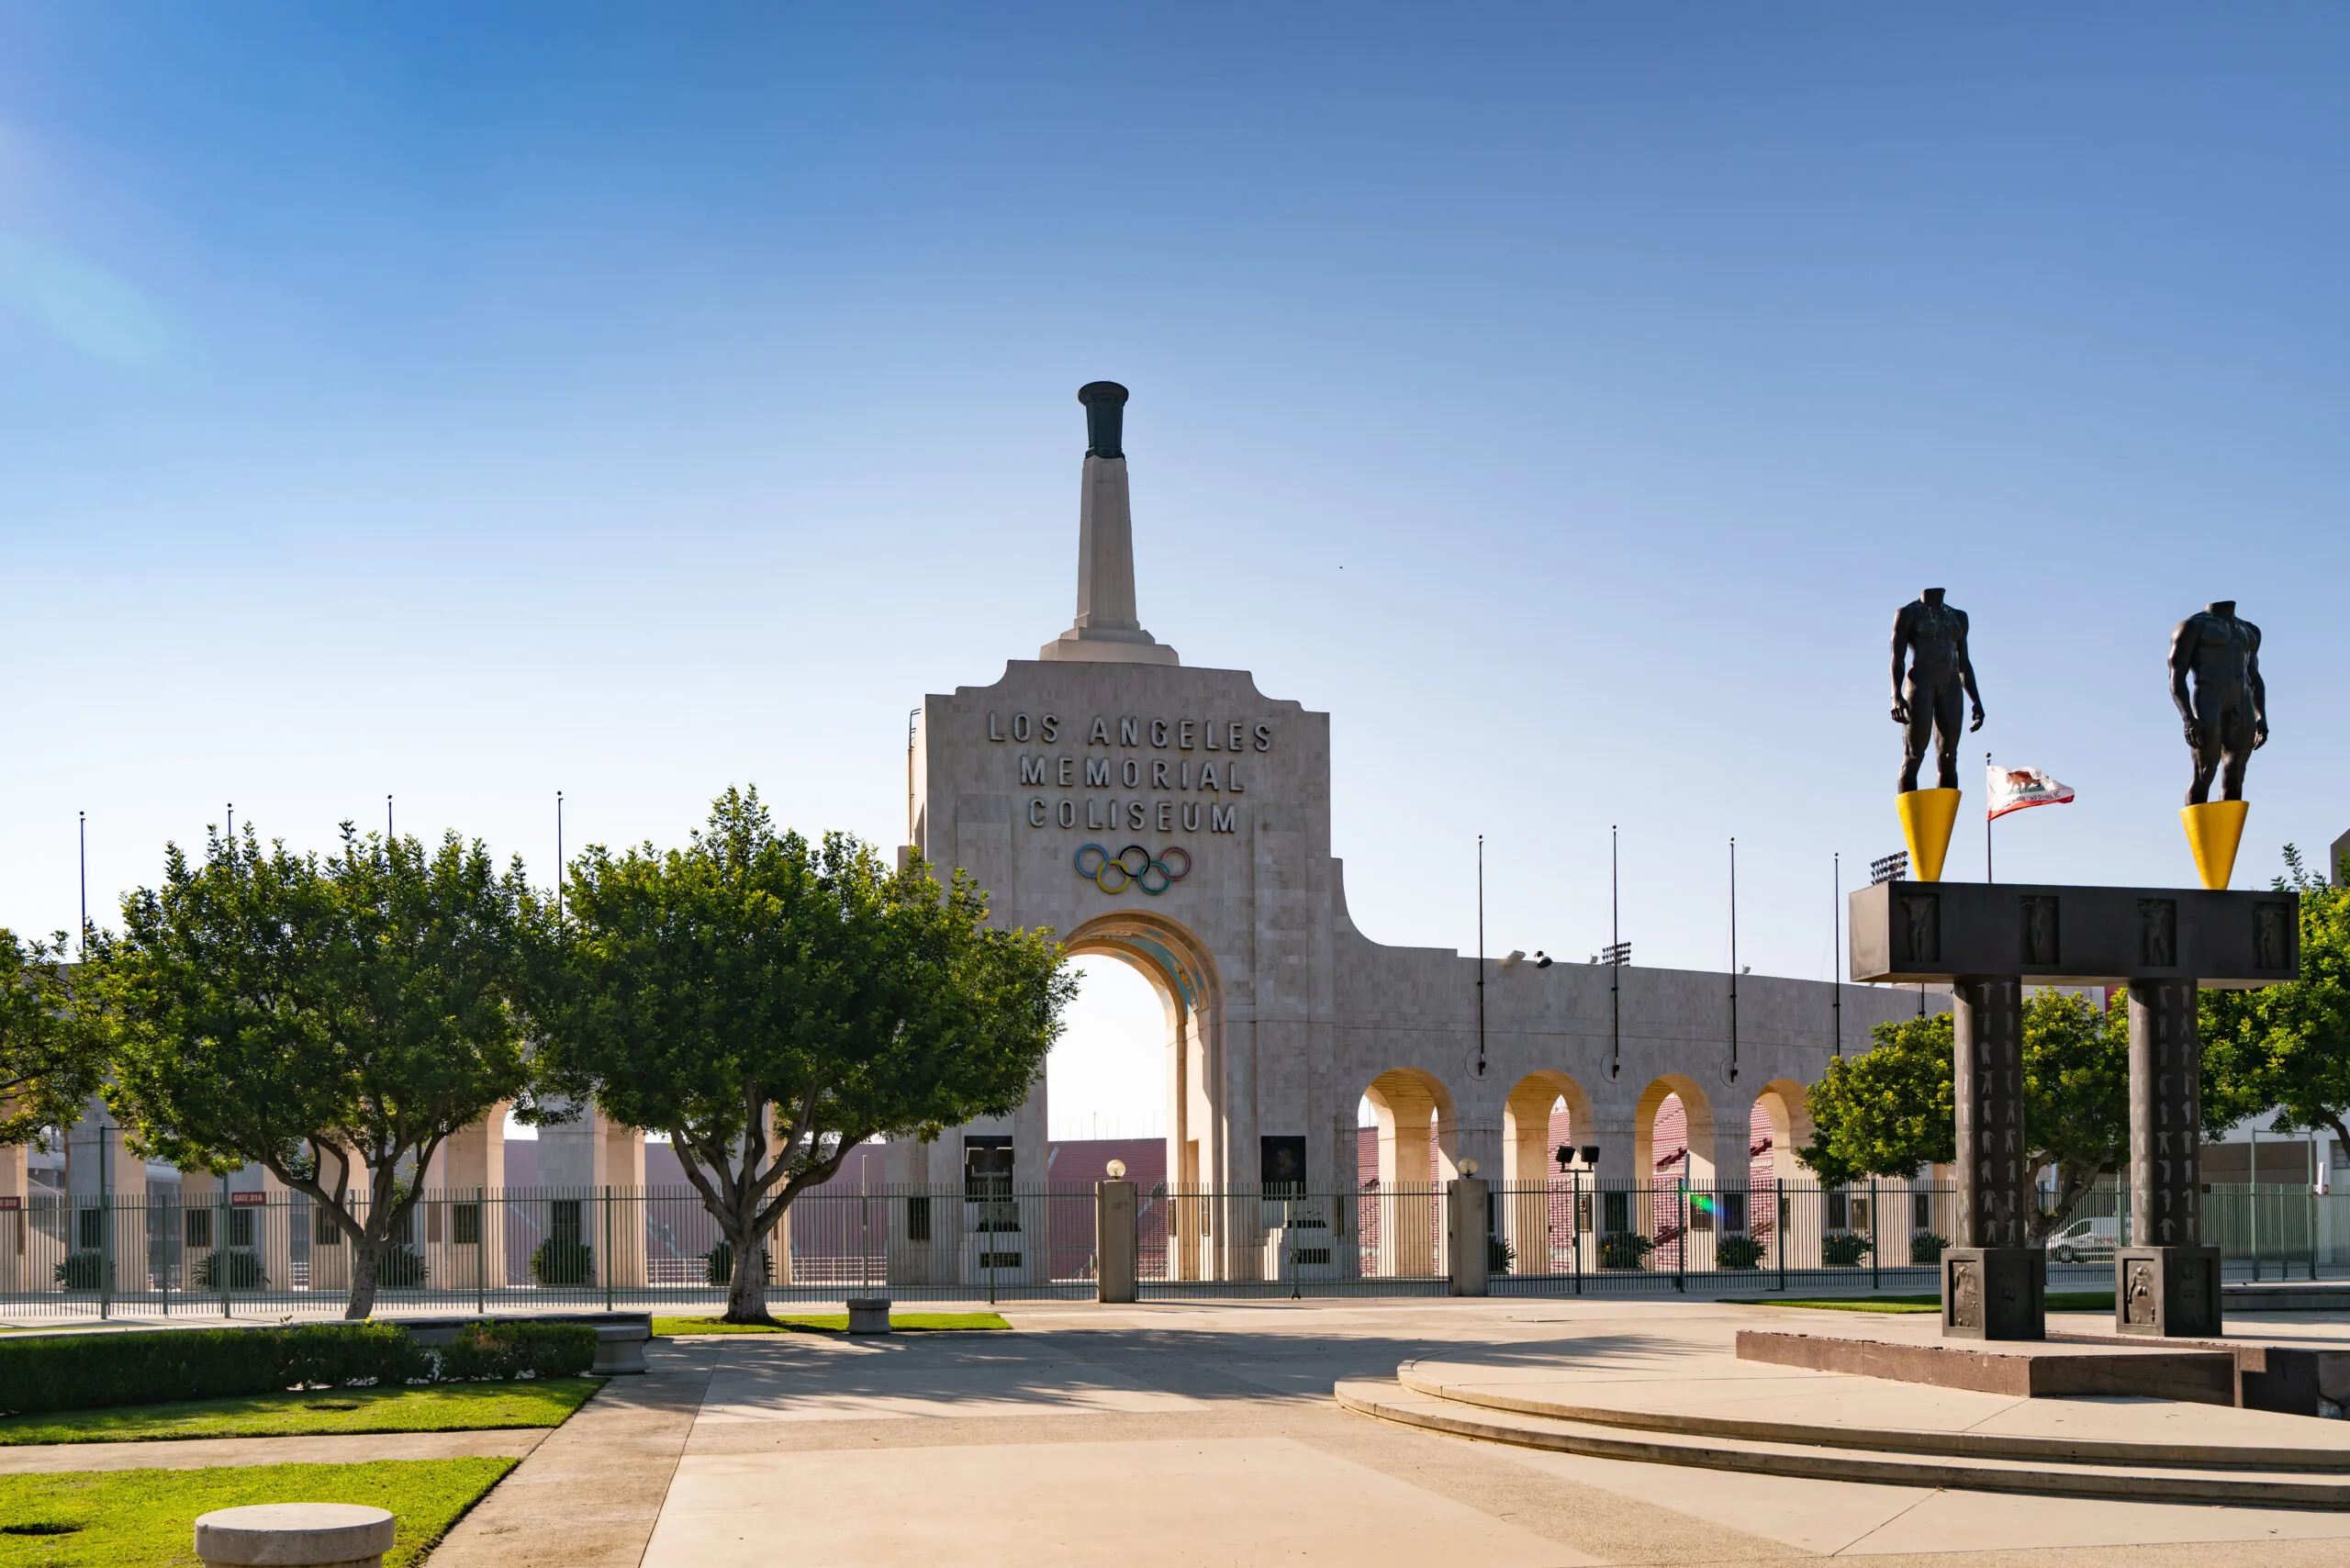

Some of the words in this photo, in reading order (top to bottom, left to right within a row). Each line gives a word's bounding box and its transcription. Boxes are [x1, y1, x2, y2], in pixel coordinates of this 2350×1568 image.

[988, 711, 1059, 743] LOS
[1088, 715, 1271, 752] ANGELES
[1020, 754, 1245, 792] MEMORIAL
[1028, 797, 1237, 834] COLISEUM
[233, 1194, 250, 1203] GATE
